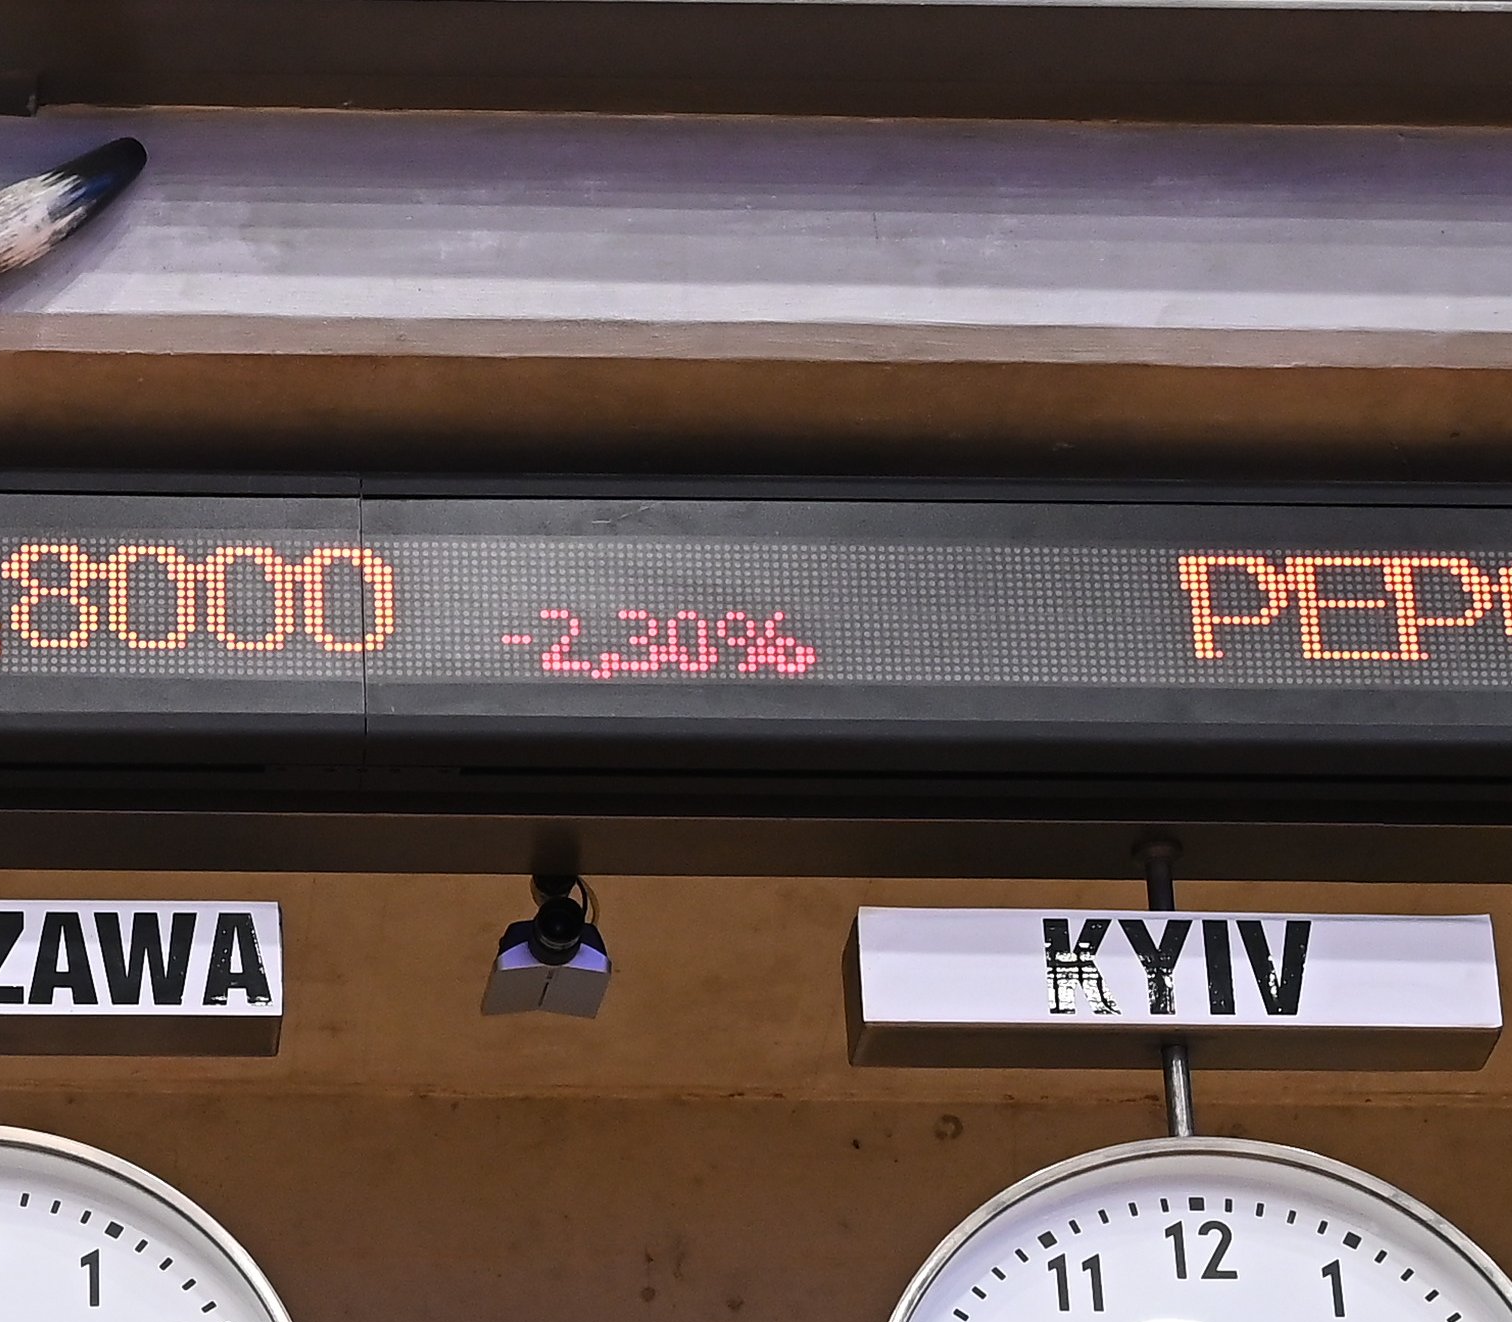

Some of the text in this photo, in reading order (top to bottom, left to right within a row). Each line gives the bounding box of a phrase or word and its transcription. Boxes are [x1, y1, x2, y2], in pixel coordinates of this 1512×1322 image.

[508, 609, 817, 679] -2,30%
[1043, 919, 1311, 1015] KYIV
[80, 1248, 100, 1307] 1
[1164, 1220, 1238, 1280] 12
[1047, 1253, 1105, 1312] 11
[1321, 1259, 1346, 1318] 1
